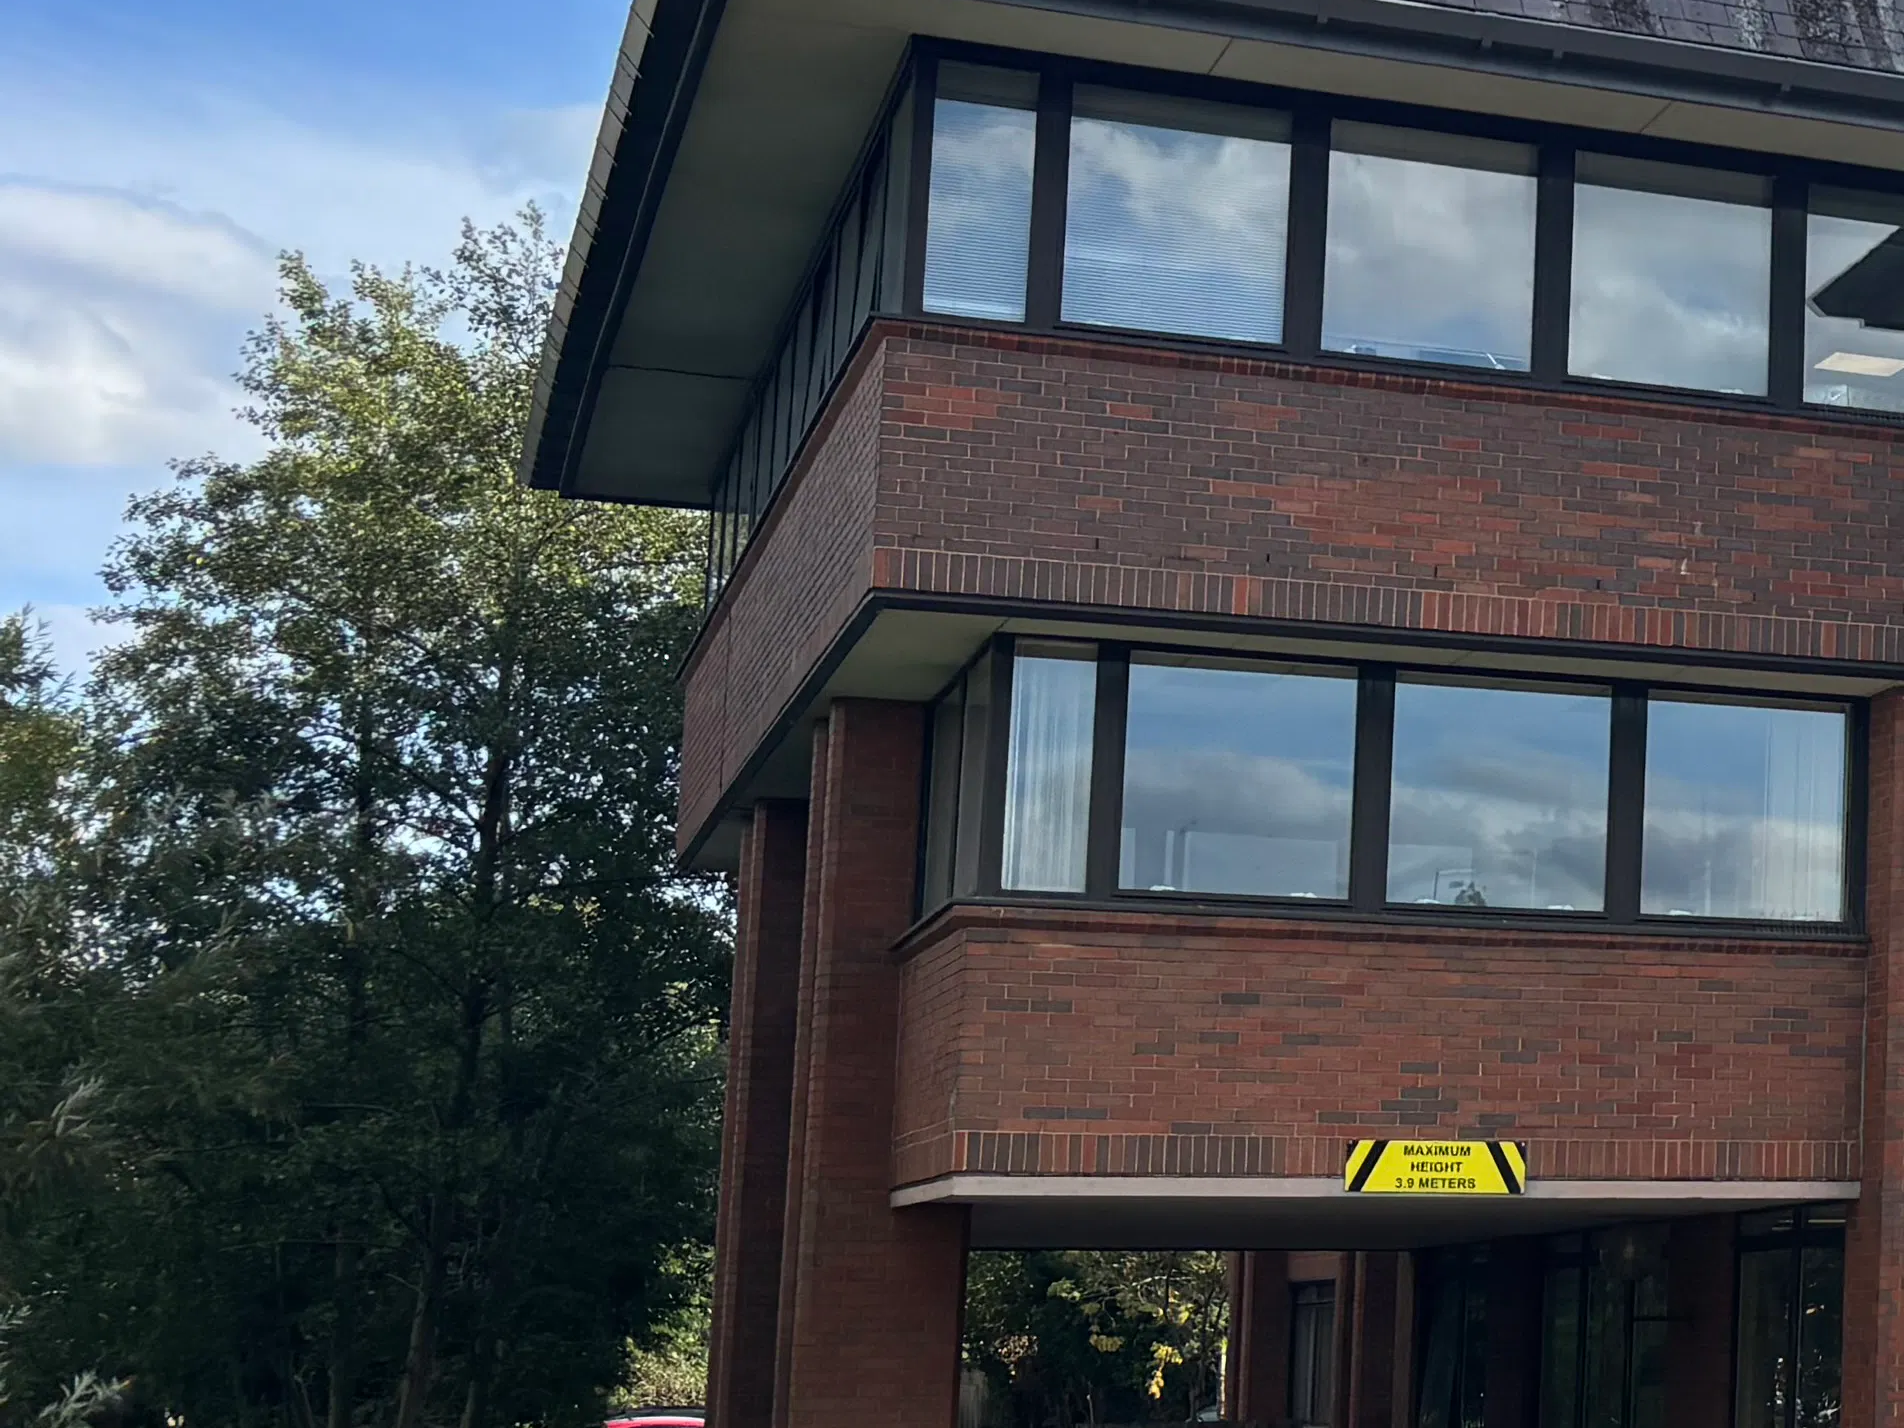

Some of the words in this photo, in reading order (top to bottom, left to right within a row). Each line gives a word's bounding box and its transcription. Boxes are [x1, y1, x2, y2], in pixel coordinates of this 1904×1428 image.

[1403, 1145, 1471, 1156] MAXIMUM
[1410, 1161, 1463, 1172] HEIGHT
[1395, 1177, 1414, 1188] 3.9
[1418, 1177, 1476, 1189] METERS
